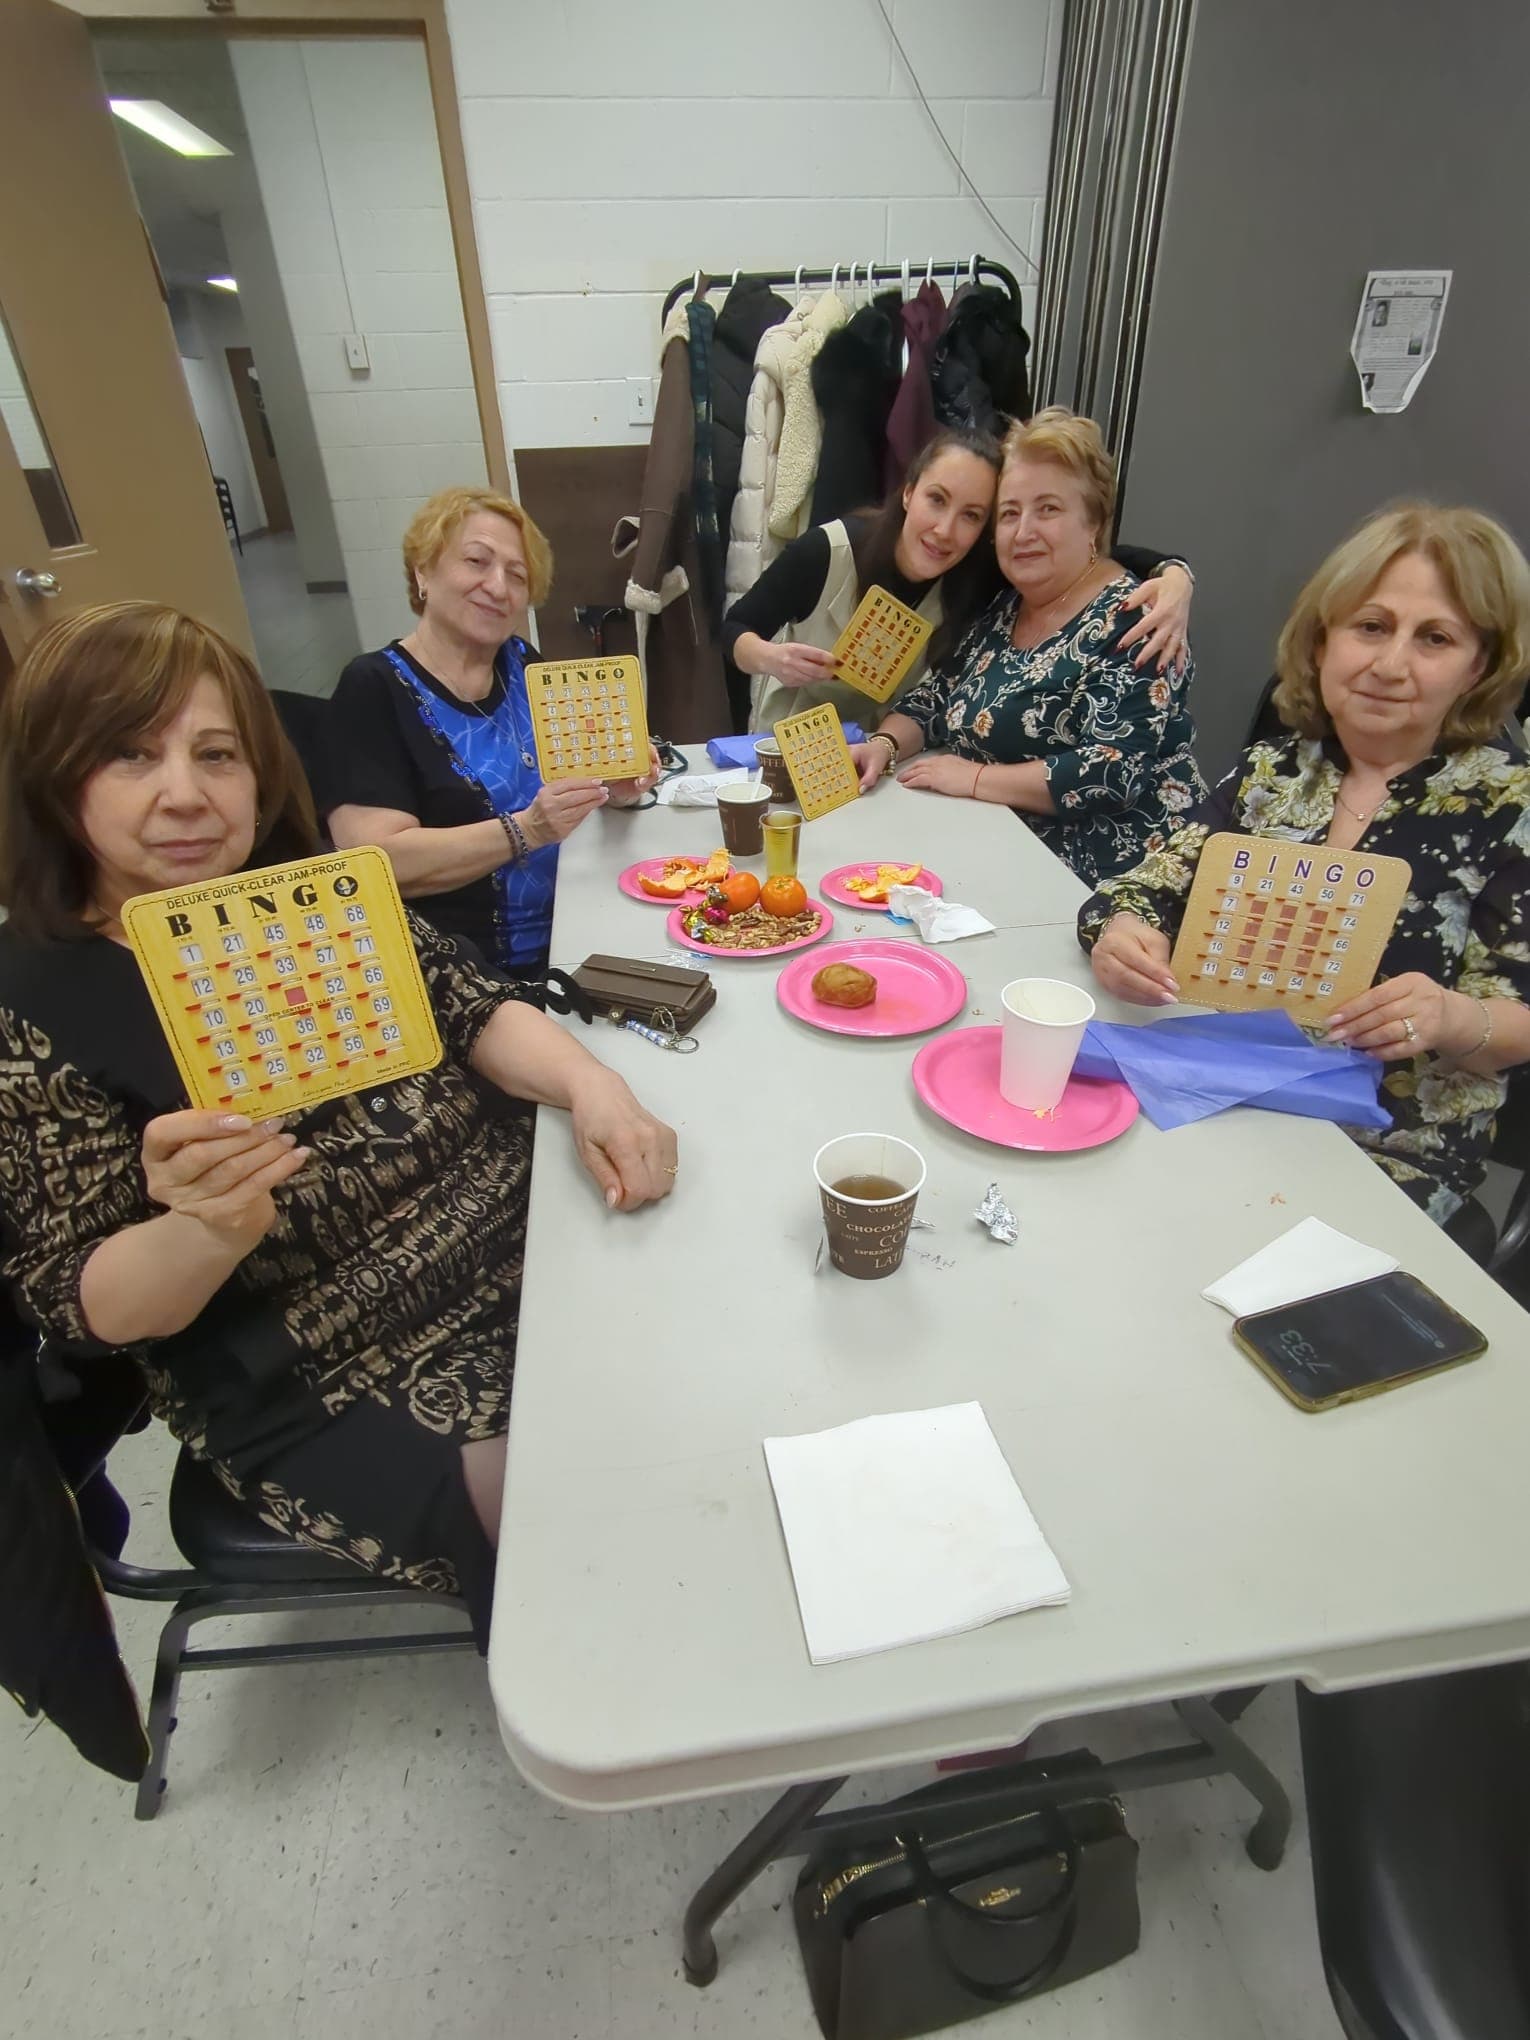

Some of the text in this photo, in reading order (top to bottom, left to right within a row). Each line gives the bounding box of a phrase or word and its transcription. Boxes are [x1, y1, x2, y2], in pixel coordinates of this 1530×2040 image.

[167, 861, 347, 909] DELUXE QUICK-CLEAR JAM-PROOF
[1232, 876, 1364, 904] 9 21 43 50 71
[186, 907, 364, 961] 1 21 45 48 68
[1218, 921, 1348, 949] 12 66
[1226, 898, 1357, 927] 7 74
[193, 938, 372, 995] 12 26 33 57 71
[1205, 963, 1332, 992] 11 28 40 54 62
[1212, 943, 1340, 971] 10 72
[206, 968, 382, 1026] 10 20 52 66
[217, 997, 390, 1057] 13 30 36 46 69
[231, 1026, 398, 1085] 9 25 32 56 62
